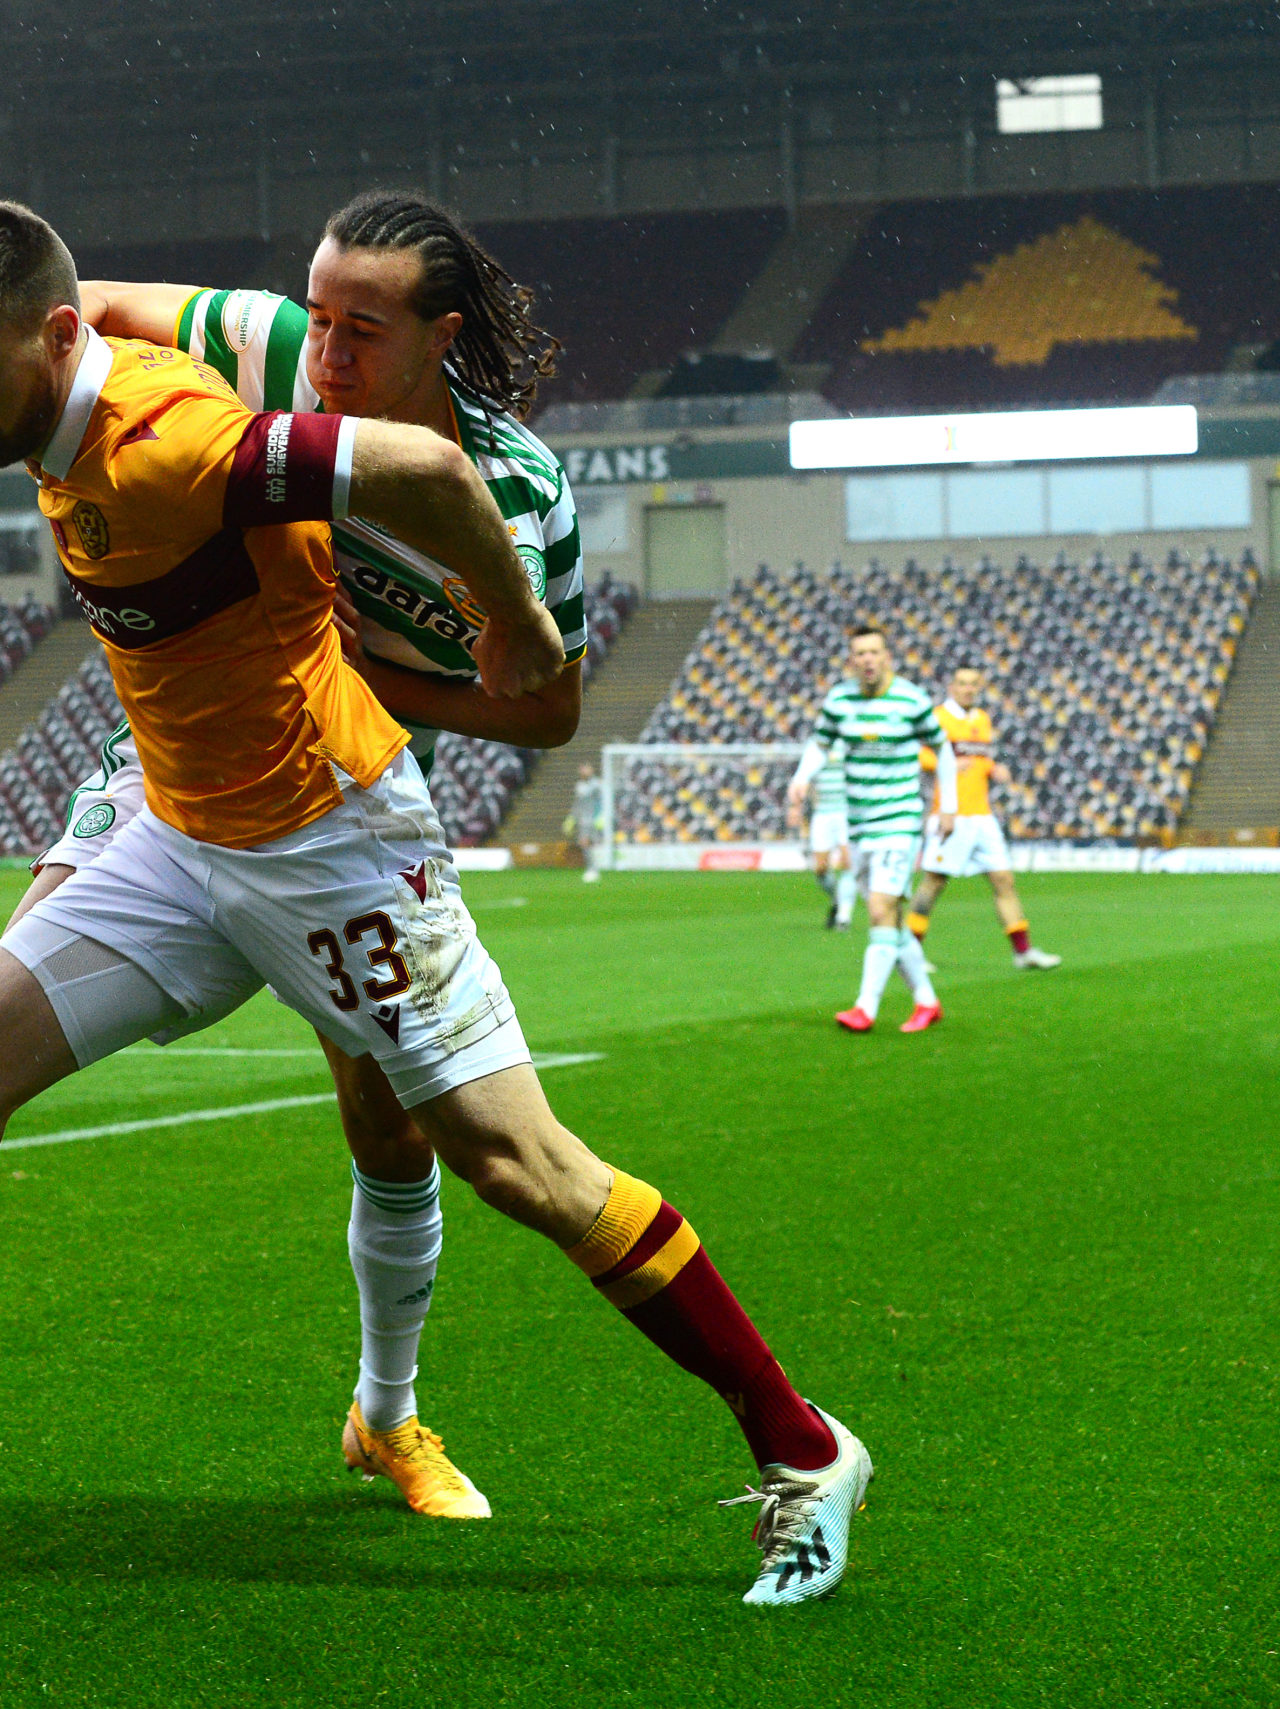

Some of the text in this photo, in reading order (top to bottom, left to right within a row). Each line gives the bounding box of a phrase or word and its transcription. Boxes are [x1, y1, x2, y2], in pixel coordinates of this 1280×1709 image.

[567, 446, 669, 482] FANS
[353, 566, 482, 653] dafa
[307, 910, 413, 1012] 33
